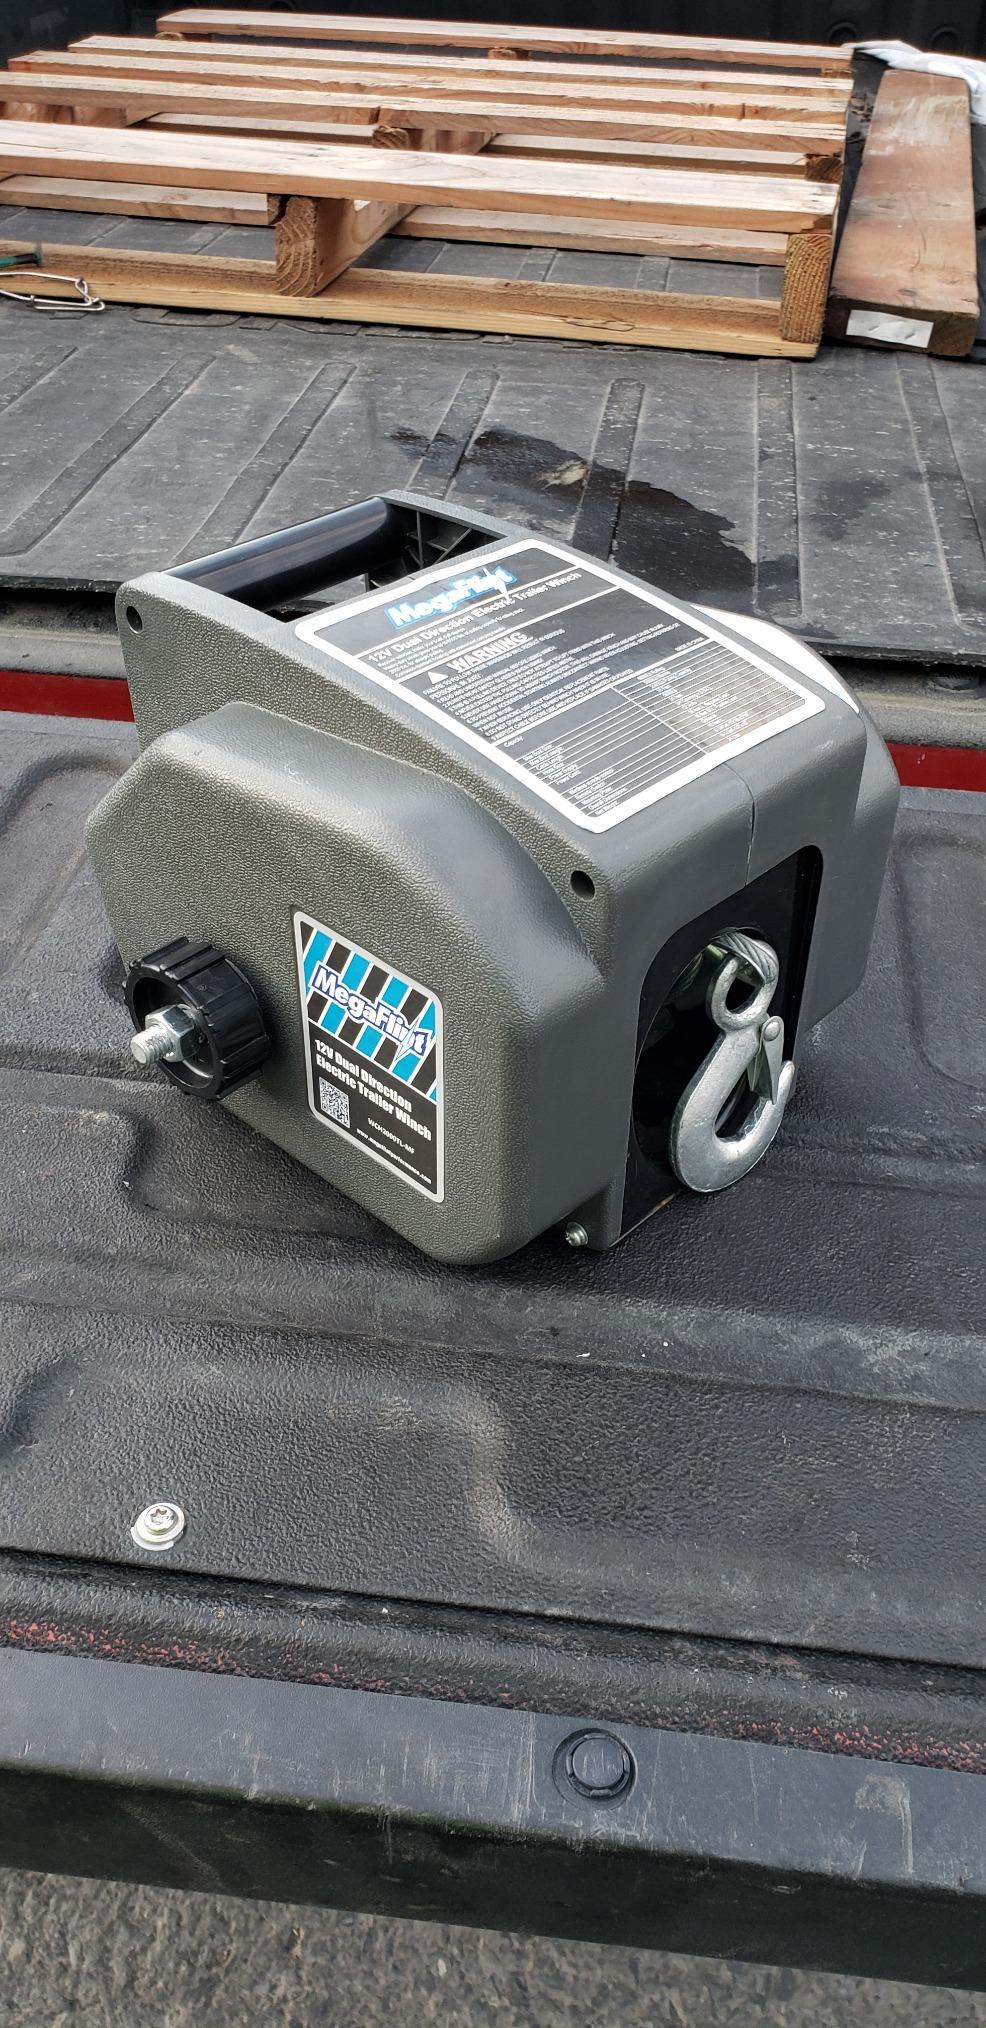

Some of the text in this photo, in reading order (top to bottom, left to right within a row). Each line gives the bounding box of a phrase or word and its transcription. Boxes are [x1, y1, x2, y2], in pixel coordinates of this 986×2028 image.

[368, 571, 582, 663] 12V Dual Direction Electric Trailer Winch
[447, 631, 530, 672] WARNING
[311, 963, 430, 1058] MegaFlint
[314, 1039, 412, 1113] 12V Dual Direction
[316, 1053, 432, 1141] Electric Trailer Winch
